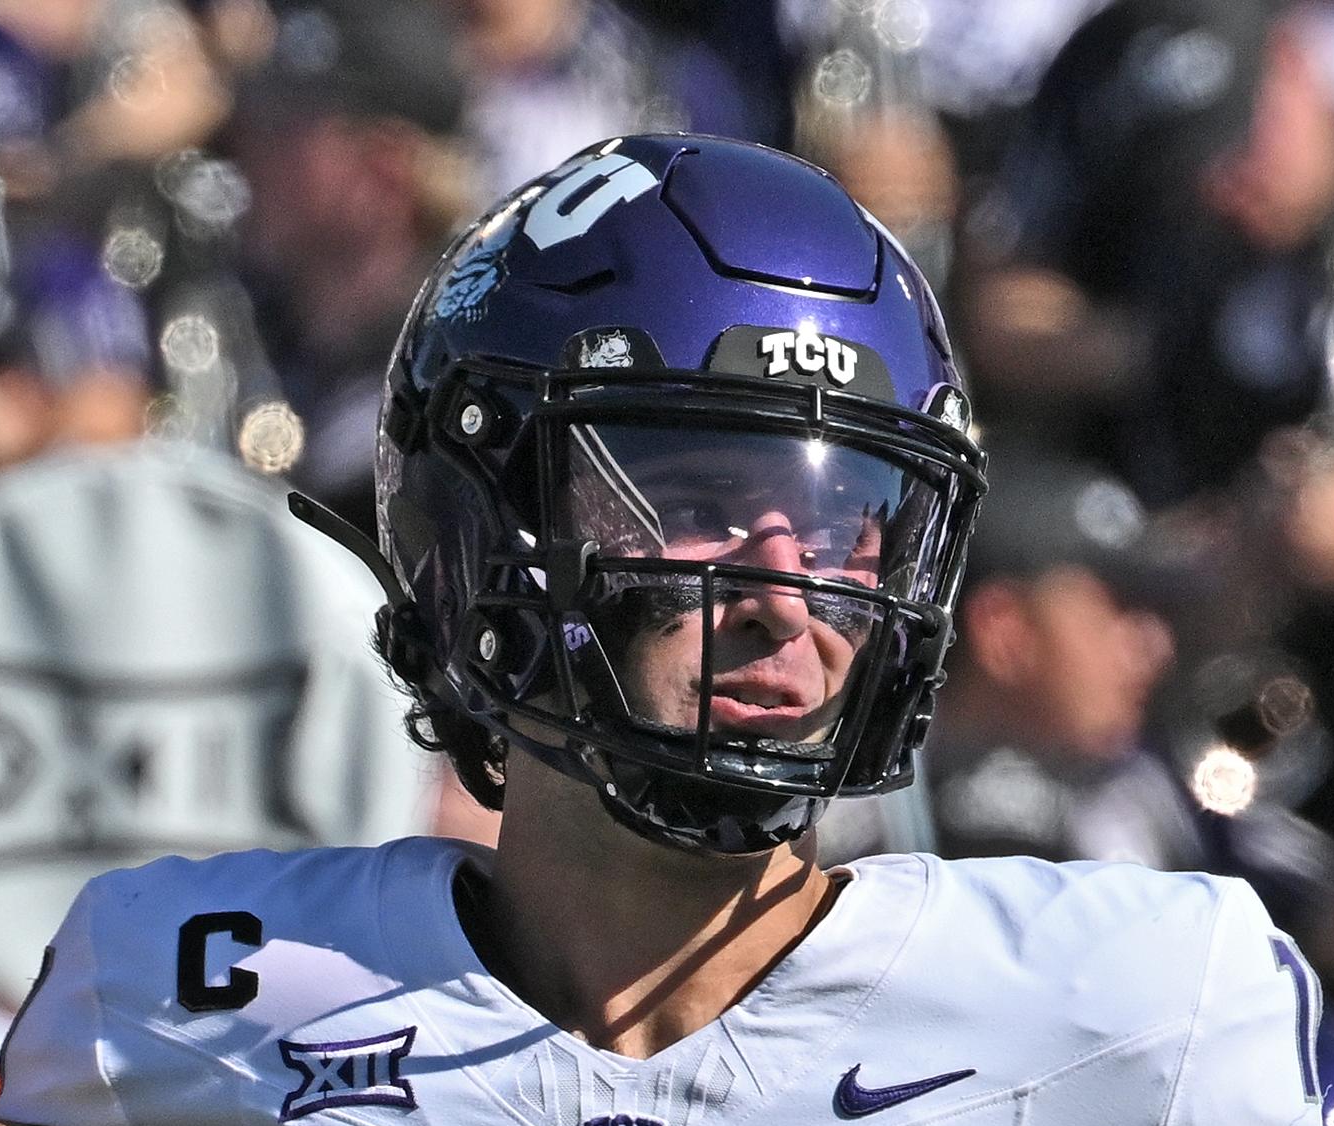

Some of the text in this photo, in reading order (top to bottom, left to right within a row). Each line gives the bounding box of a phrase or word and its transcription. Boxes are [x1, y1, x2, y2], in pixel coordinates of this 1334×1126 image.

[758, 331, 858, 387] TCU
[177, 911, 262, 1012] C
[1267, 935, 1325, 1105] 1
[282, 1029, 415, 1119] XII
